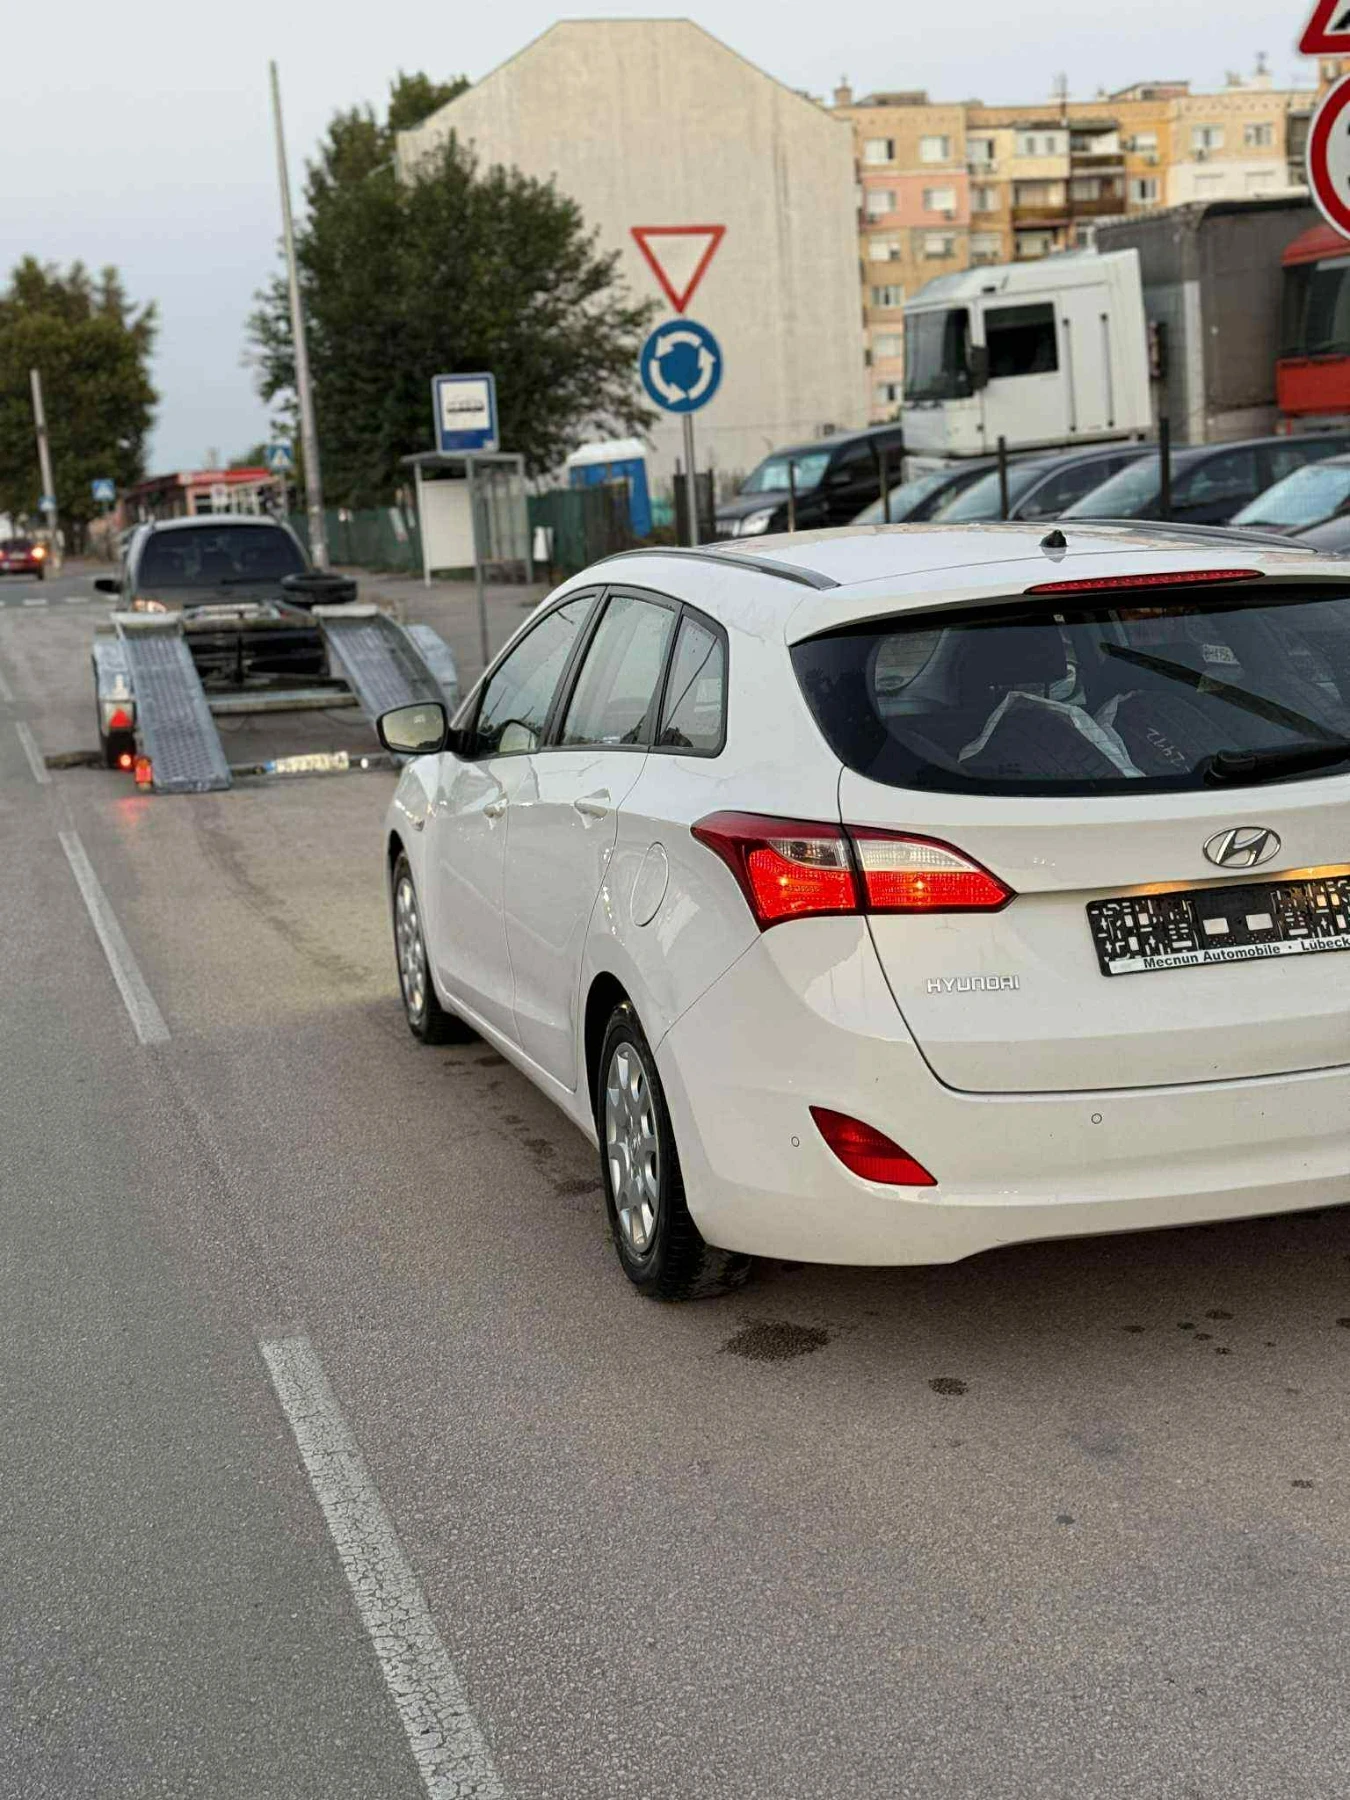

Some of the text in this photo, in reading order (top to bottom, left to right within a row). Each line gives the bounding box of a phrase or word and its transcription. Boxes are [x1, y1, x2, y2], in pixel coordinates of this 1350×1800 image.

[1143, 936, 1350, 969] Mecnun Automobile Lübeck
[927, 975, 1020, 993] HYUNDAI
